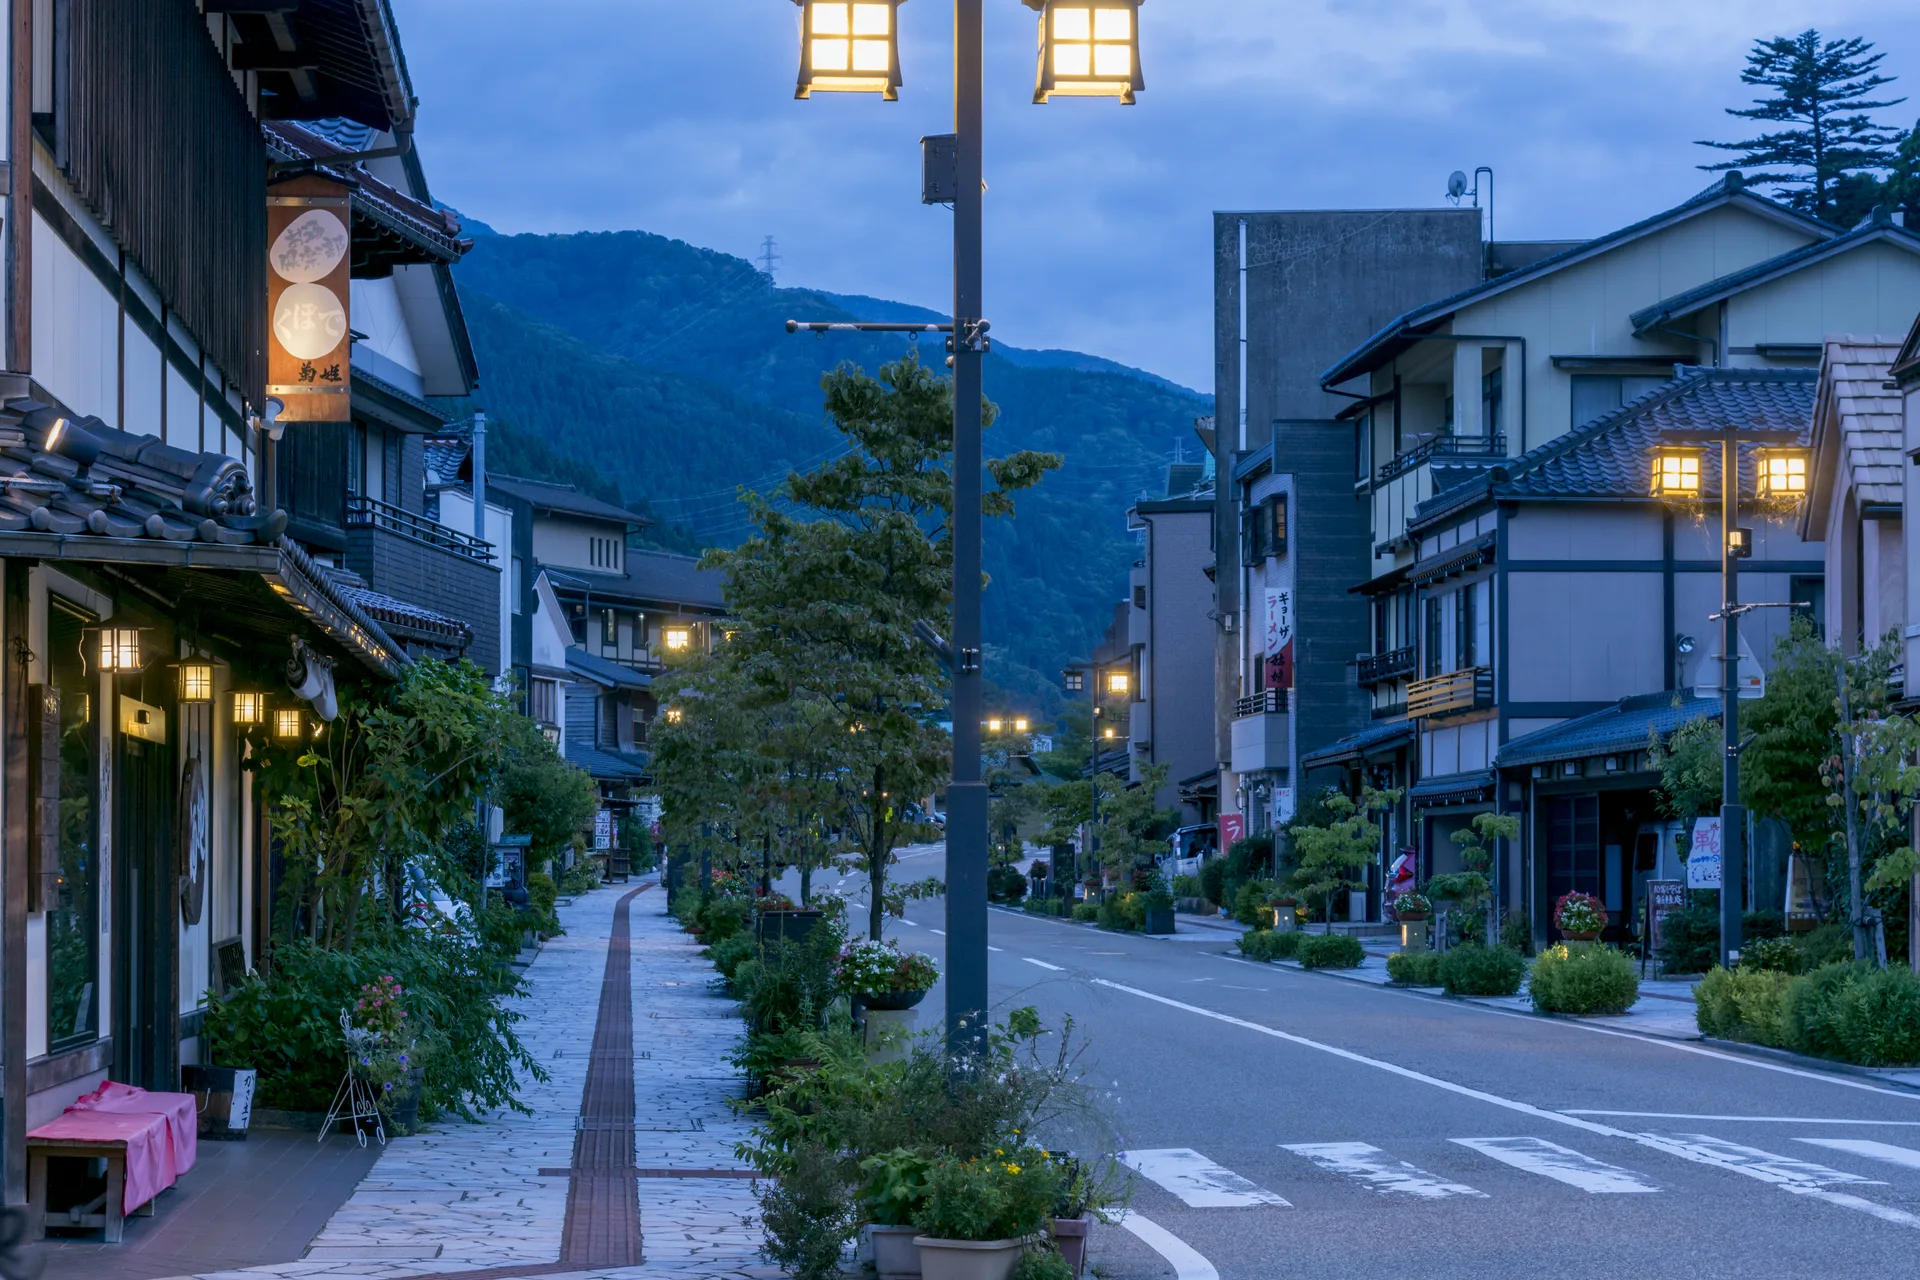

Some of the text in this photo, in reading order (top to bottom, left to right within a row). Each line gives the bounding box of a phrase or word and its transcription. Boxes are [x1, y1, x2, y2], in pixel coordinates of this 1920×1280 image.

[276, 303, 343, 341] くぼで
[298, 360, 342, 383] 菊姫
[1267, 595, 1278, 651] ラーメン
[1279, 591, 1290, 639] ギョーザ
[1226, 820, 1240, 843] ラ
[242, 1074, 255, 1129] かさ立て
